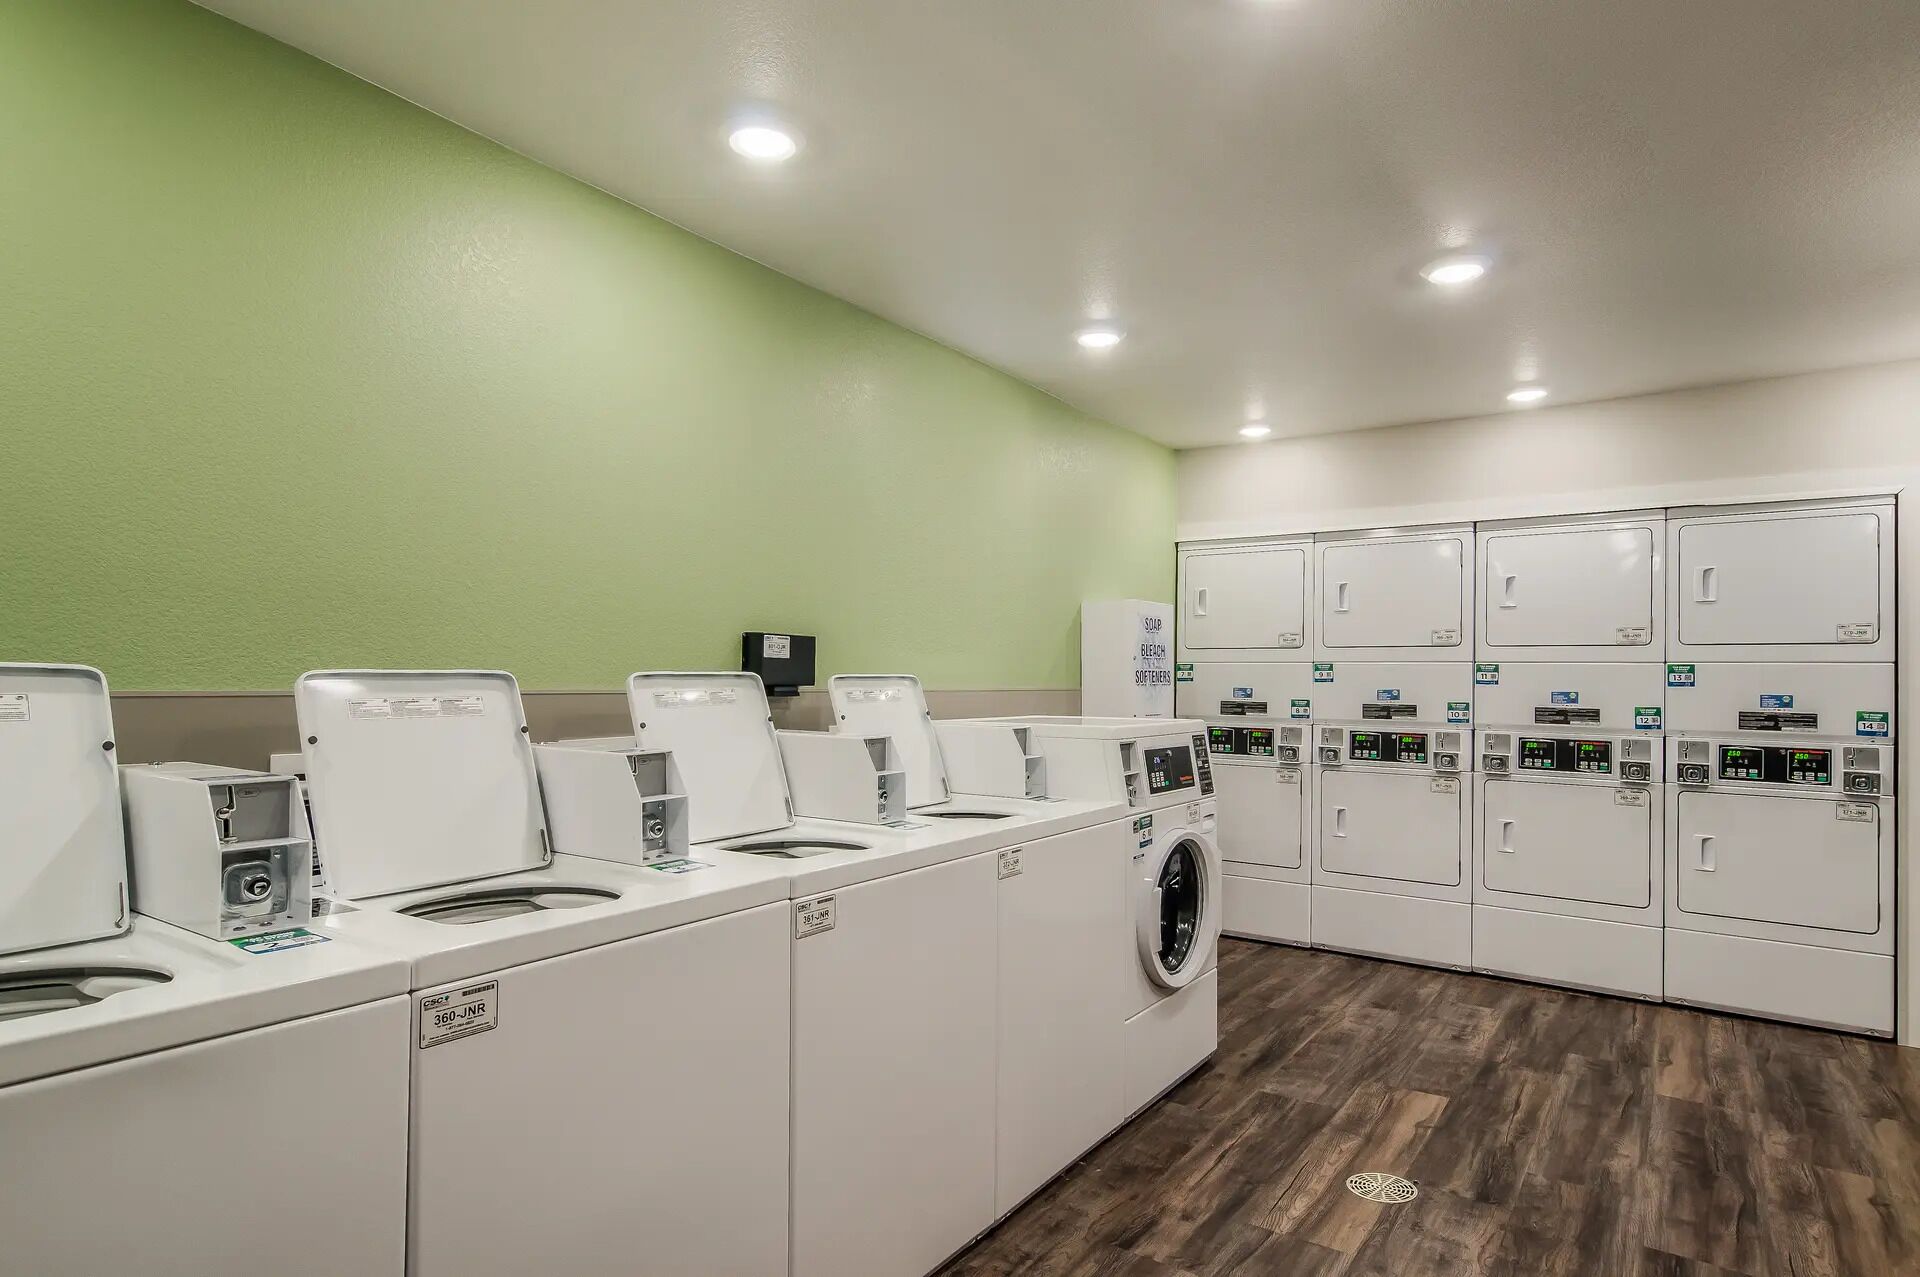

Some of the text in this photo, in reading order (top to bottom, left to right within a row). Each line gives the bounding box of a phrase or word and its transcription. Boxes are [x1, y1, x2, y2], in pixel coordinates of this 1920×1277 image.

[1144, 617, 1162, 631] SOAP
[1140, 643, 1166, 657] BLEACH
[1135, 669, 1171, 684] SOFTENERS
[423, 996, 444, 1007] CSC
[434, 1002, 486, 1026] 360-JNR
